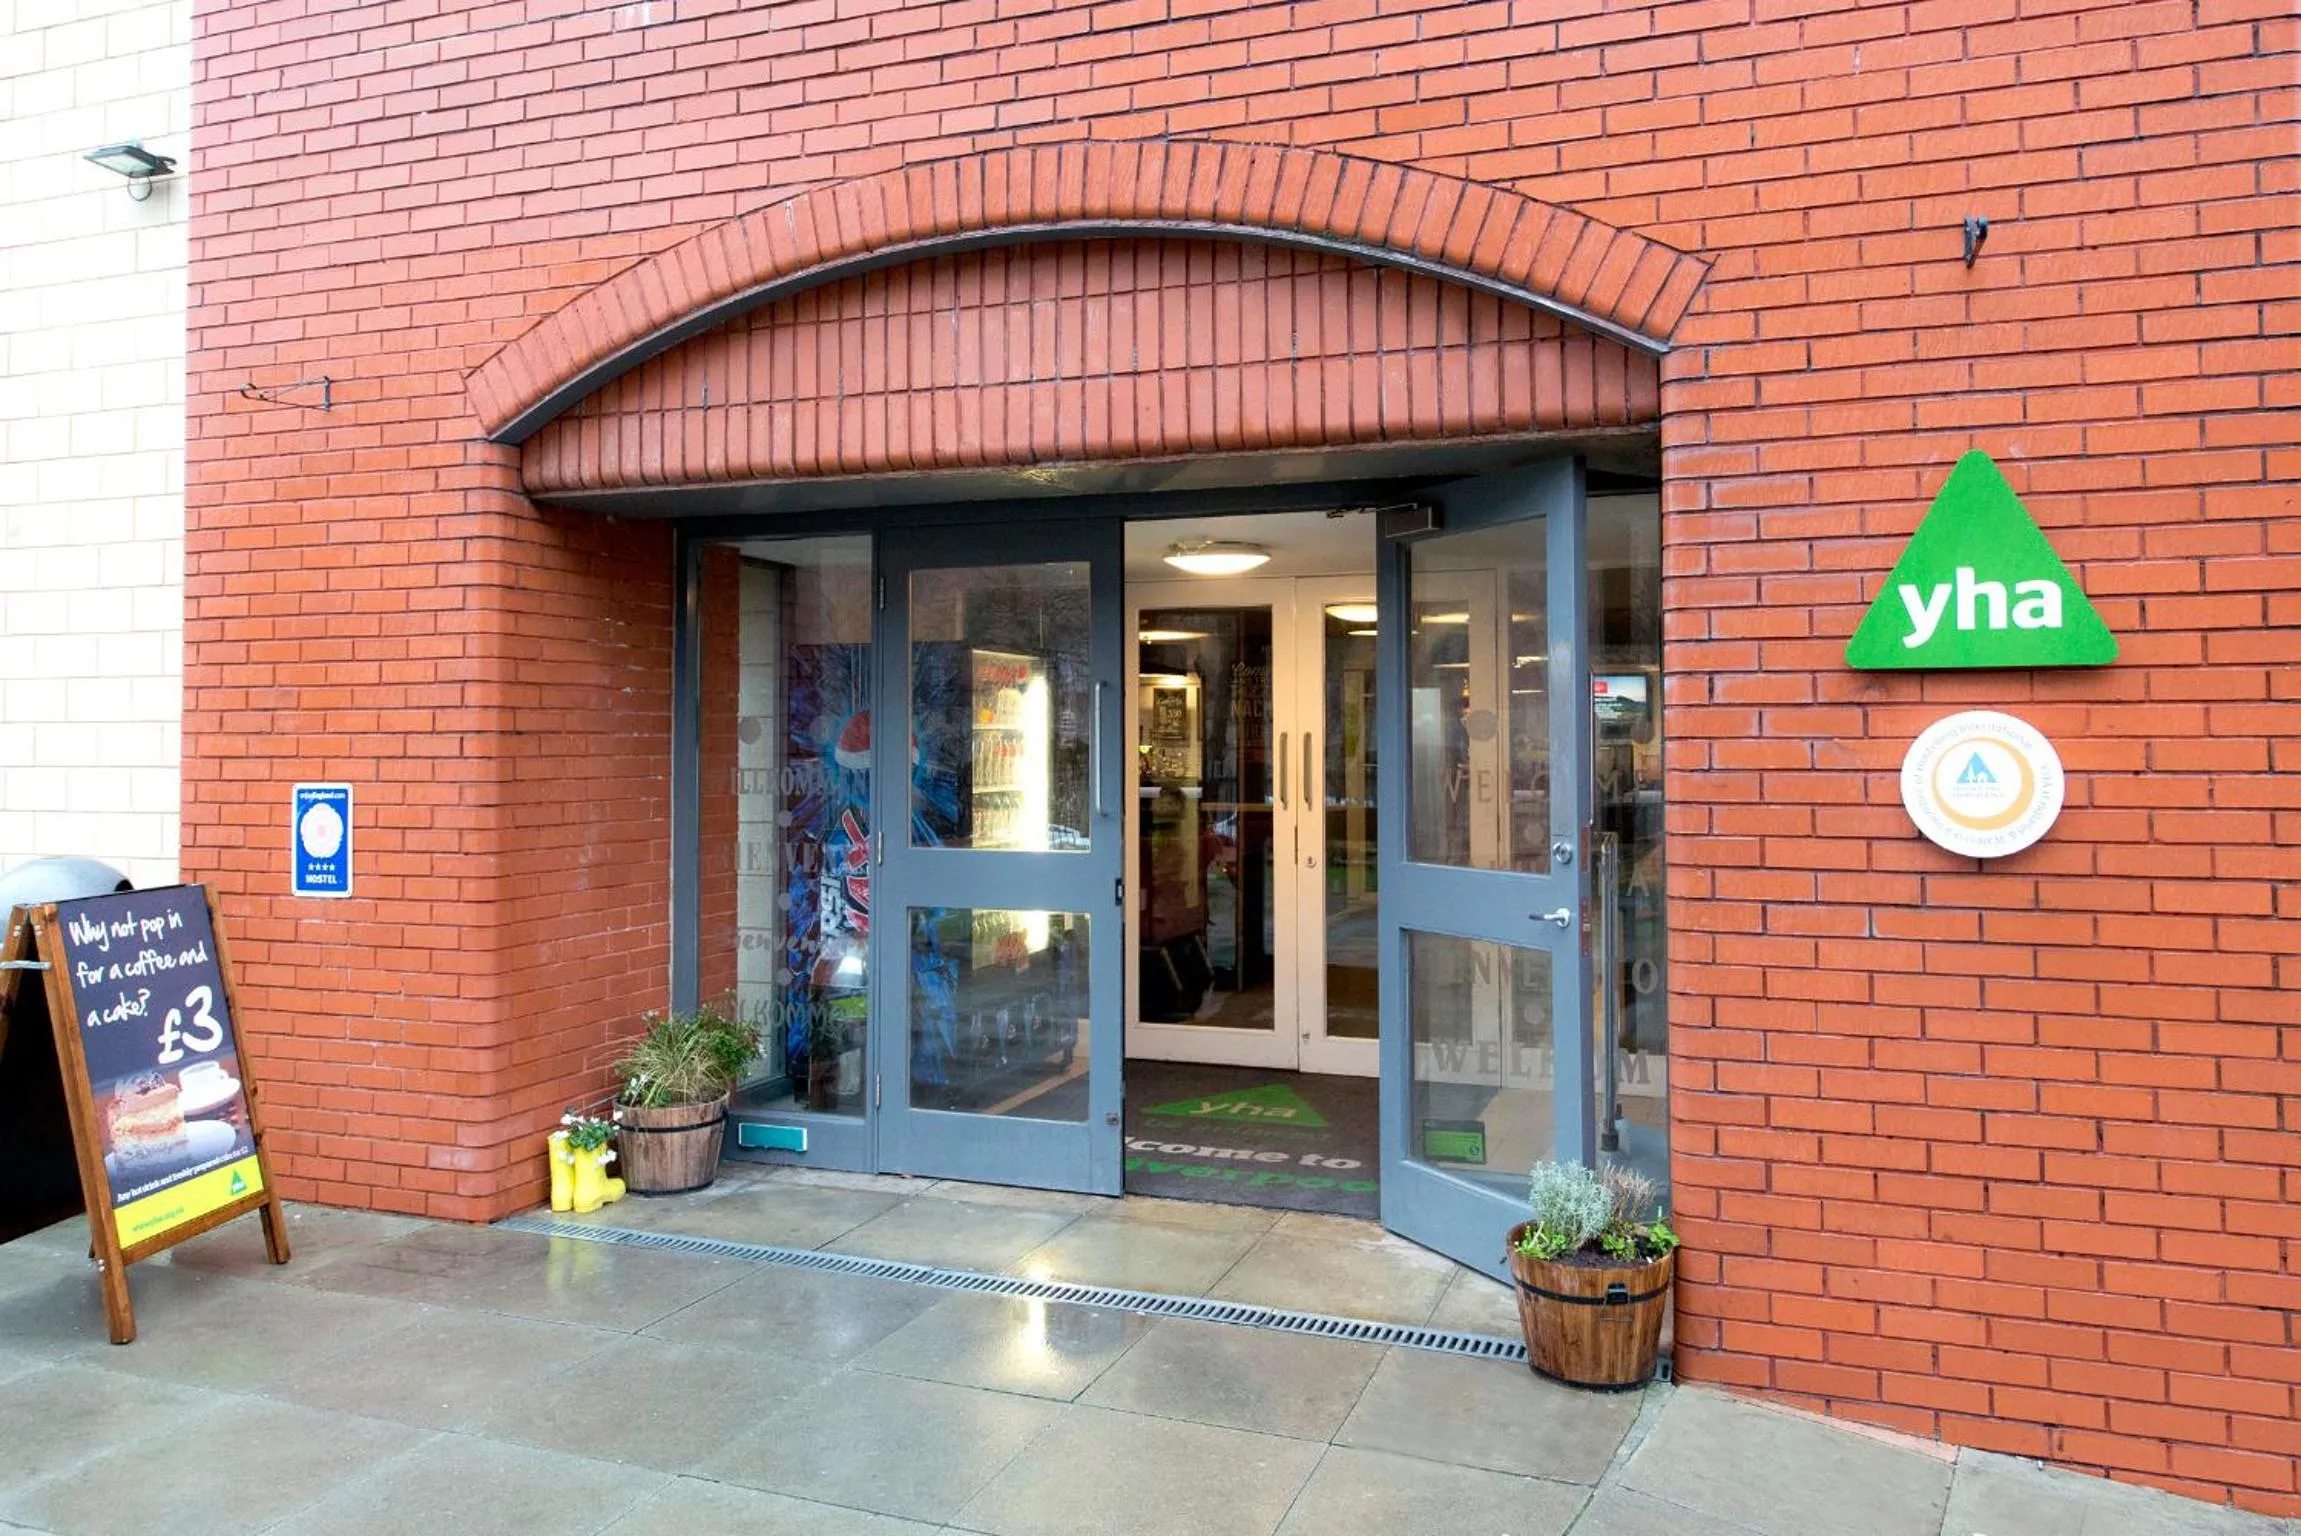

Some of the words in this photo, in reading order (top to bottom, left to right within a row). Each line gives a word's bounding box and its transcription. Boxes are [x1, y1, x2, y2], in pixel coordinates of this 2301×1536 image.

[1896, 566, 2064, 649] yha
[305, 874, 338, 885] HOSTEL
[68, 912, 110, 951] Why
[111, 910, 138, 938] not
[140, 916, 165, 943] pop
[167, 908, 184, 929] in
[76, 961, 104, 989] for
[109, 963, 124, 980] a
[125, 949, 178, 977] coffee
[179, 939, 209, 967] and
[86, 1010, 102, 1028] a
[103, 988, 152, 1023] cake?
[157, 985, 224, 1065] £3
[1188, 1101, 1298, 1119] yha
[1299, 1152, 1362, 1170] to
